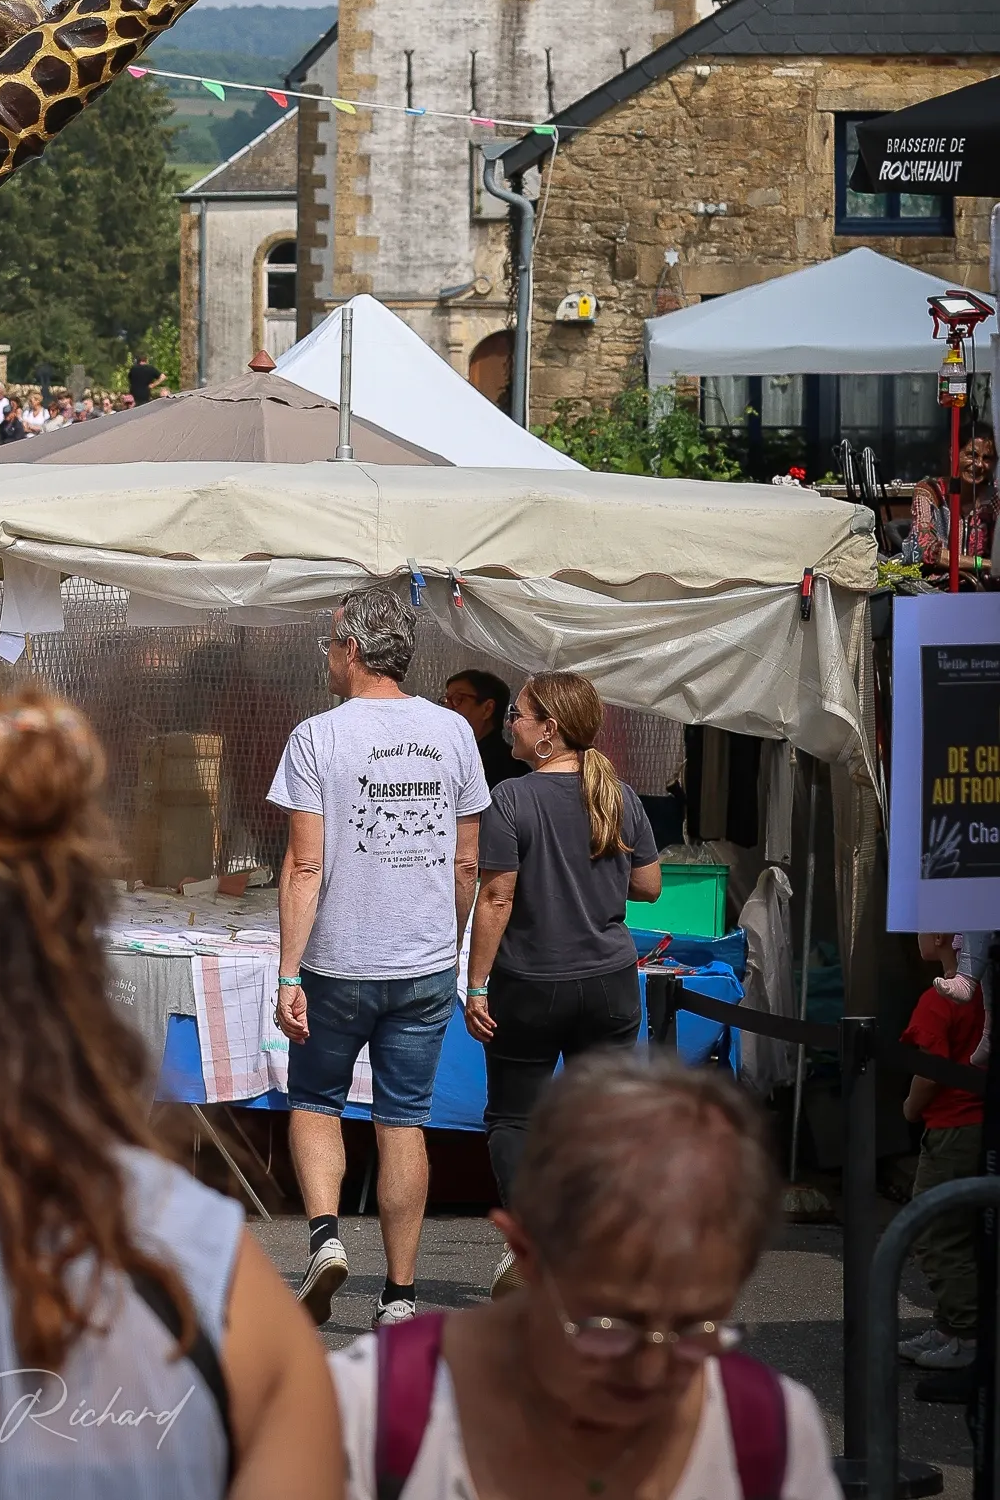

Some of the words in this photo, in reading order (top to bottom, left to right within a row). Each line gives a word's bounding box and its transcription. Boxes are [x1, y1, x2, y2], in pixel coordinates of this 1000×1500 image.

[886, 137, 947, 153] BRASSERIE
[949, 137, 966, 153] DE
[878, 160, 963, 182] ROCHEHAUT
[367, 743, 404, 764] Accueil
[407, 742, 443, 761] Public
[947, 746, 970, 773] DE
[368, 781, 442, 798] CHASSEPIERRE
[932, 777, 955, 804] AU
[968, 821, 1000, 844] Cha
